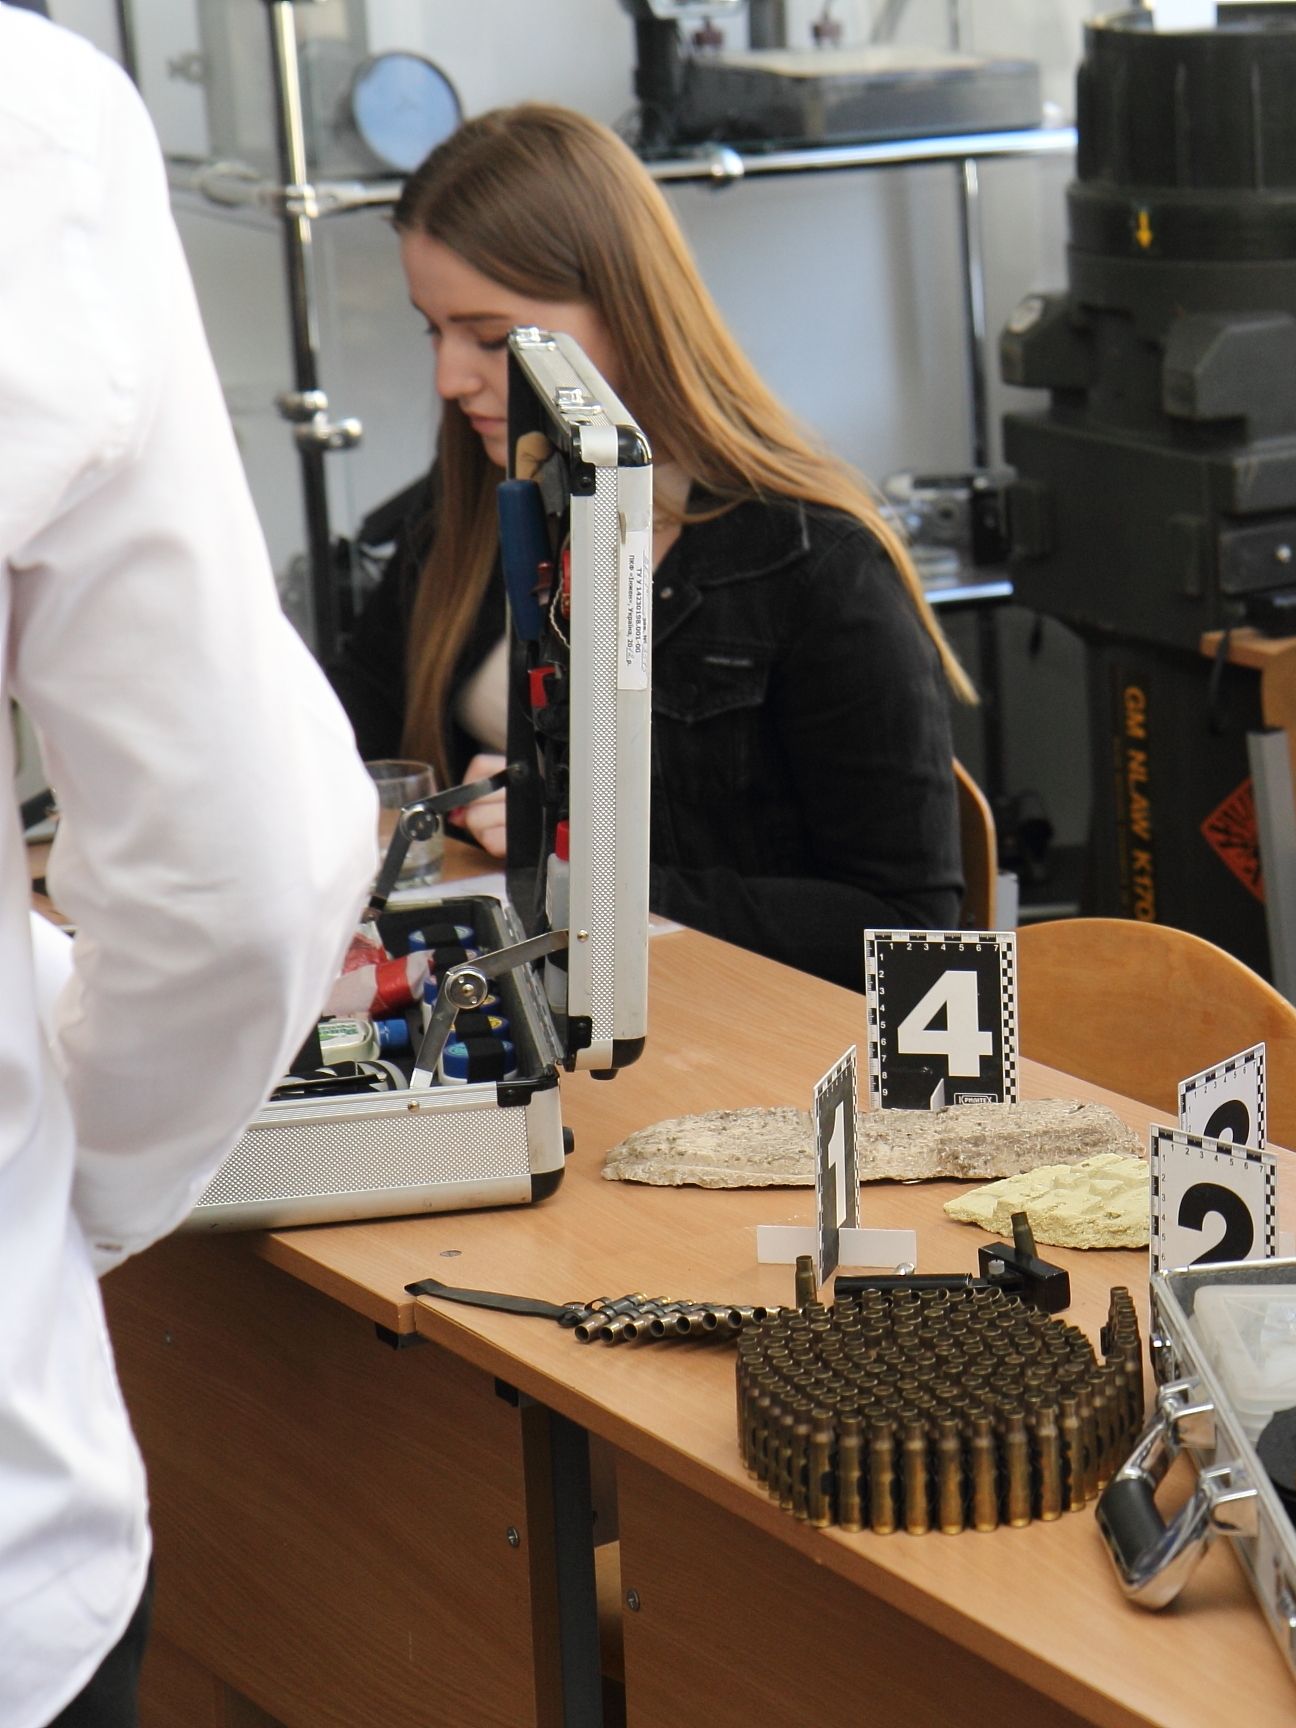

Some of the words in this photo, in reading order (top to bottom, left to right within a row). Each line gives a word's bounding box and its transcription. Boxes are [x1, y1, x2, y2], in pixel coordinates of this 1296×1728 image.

[1123, 685, 1148, 740] GM
[1126, 748, 1152, 842] NLAW
[897, 970, 993, 1077] 4
[827, 1101, 847, 1229] 1
[1178, 1182, 1255, 1265] 2
